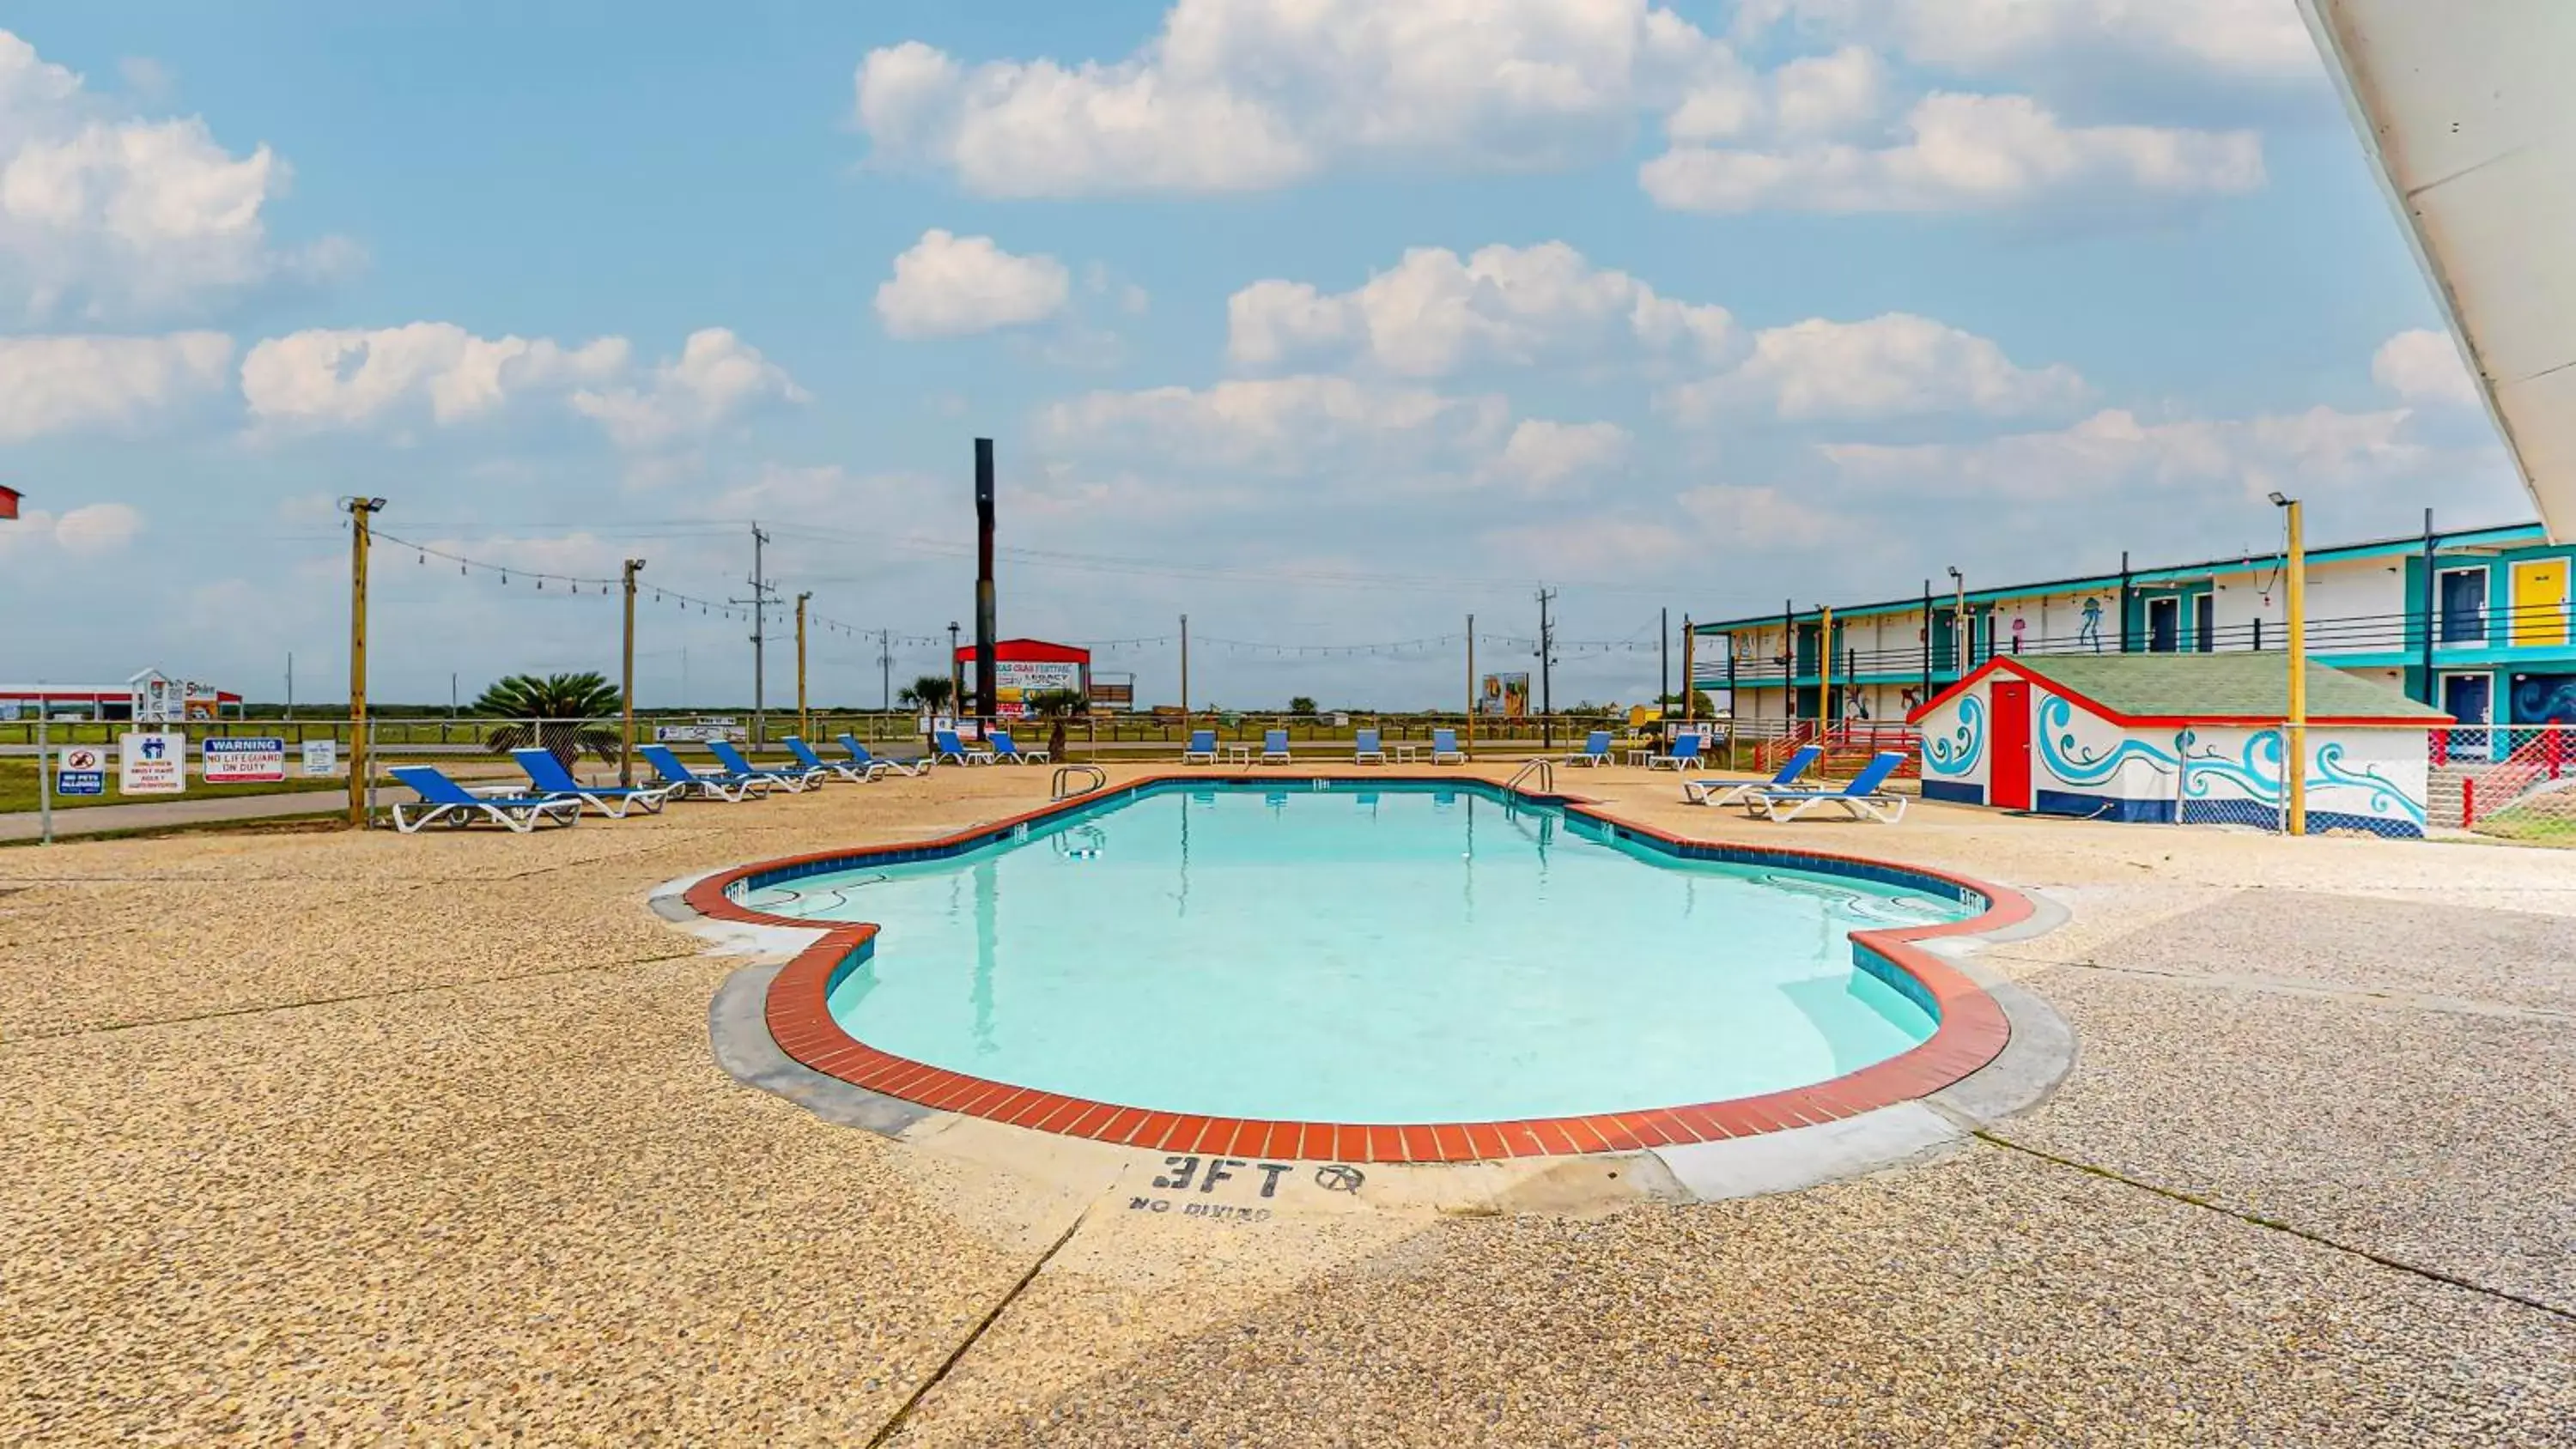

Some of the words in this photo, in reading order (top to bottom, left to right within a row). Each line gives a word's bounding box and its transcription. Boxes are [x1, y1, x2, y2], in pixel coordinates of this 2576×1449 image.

[212, 740, 276, 750] WARNING
[224, 754, 281, 763] LIFEGUARD
[1129, 1196, 1171, 1213] NO
